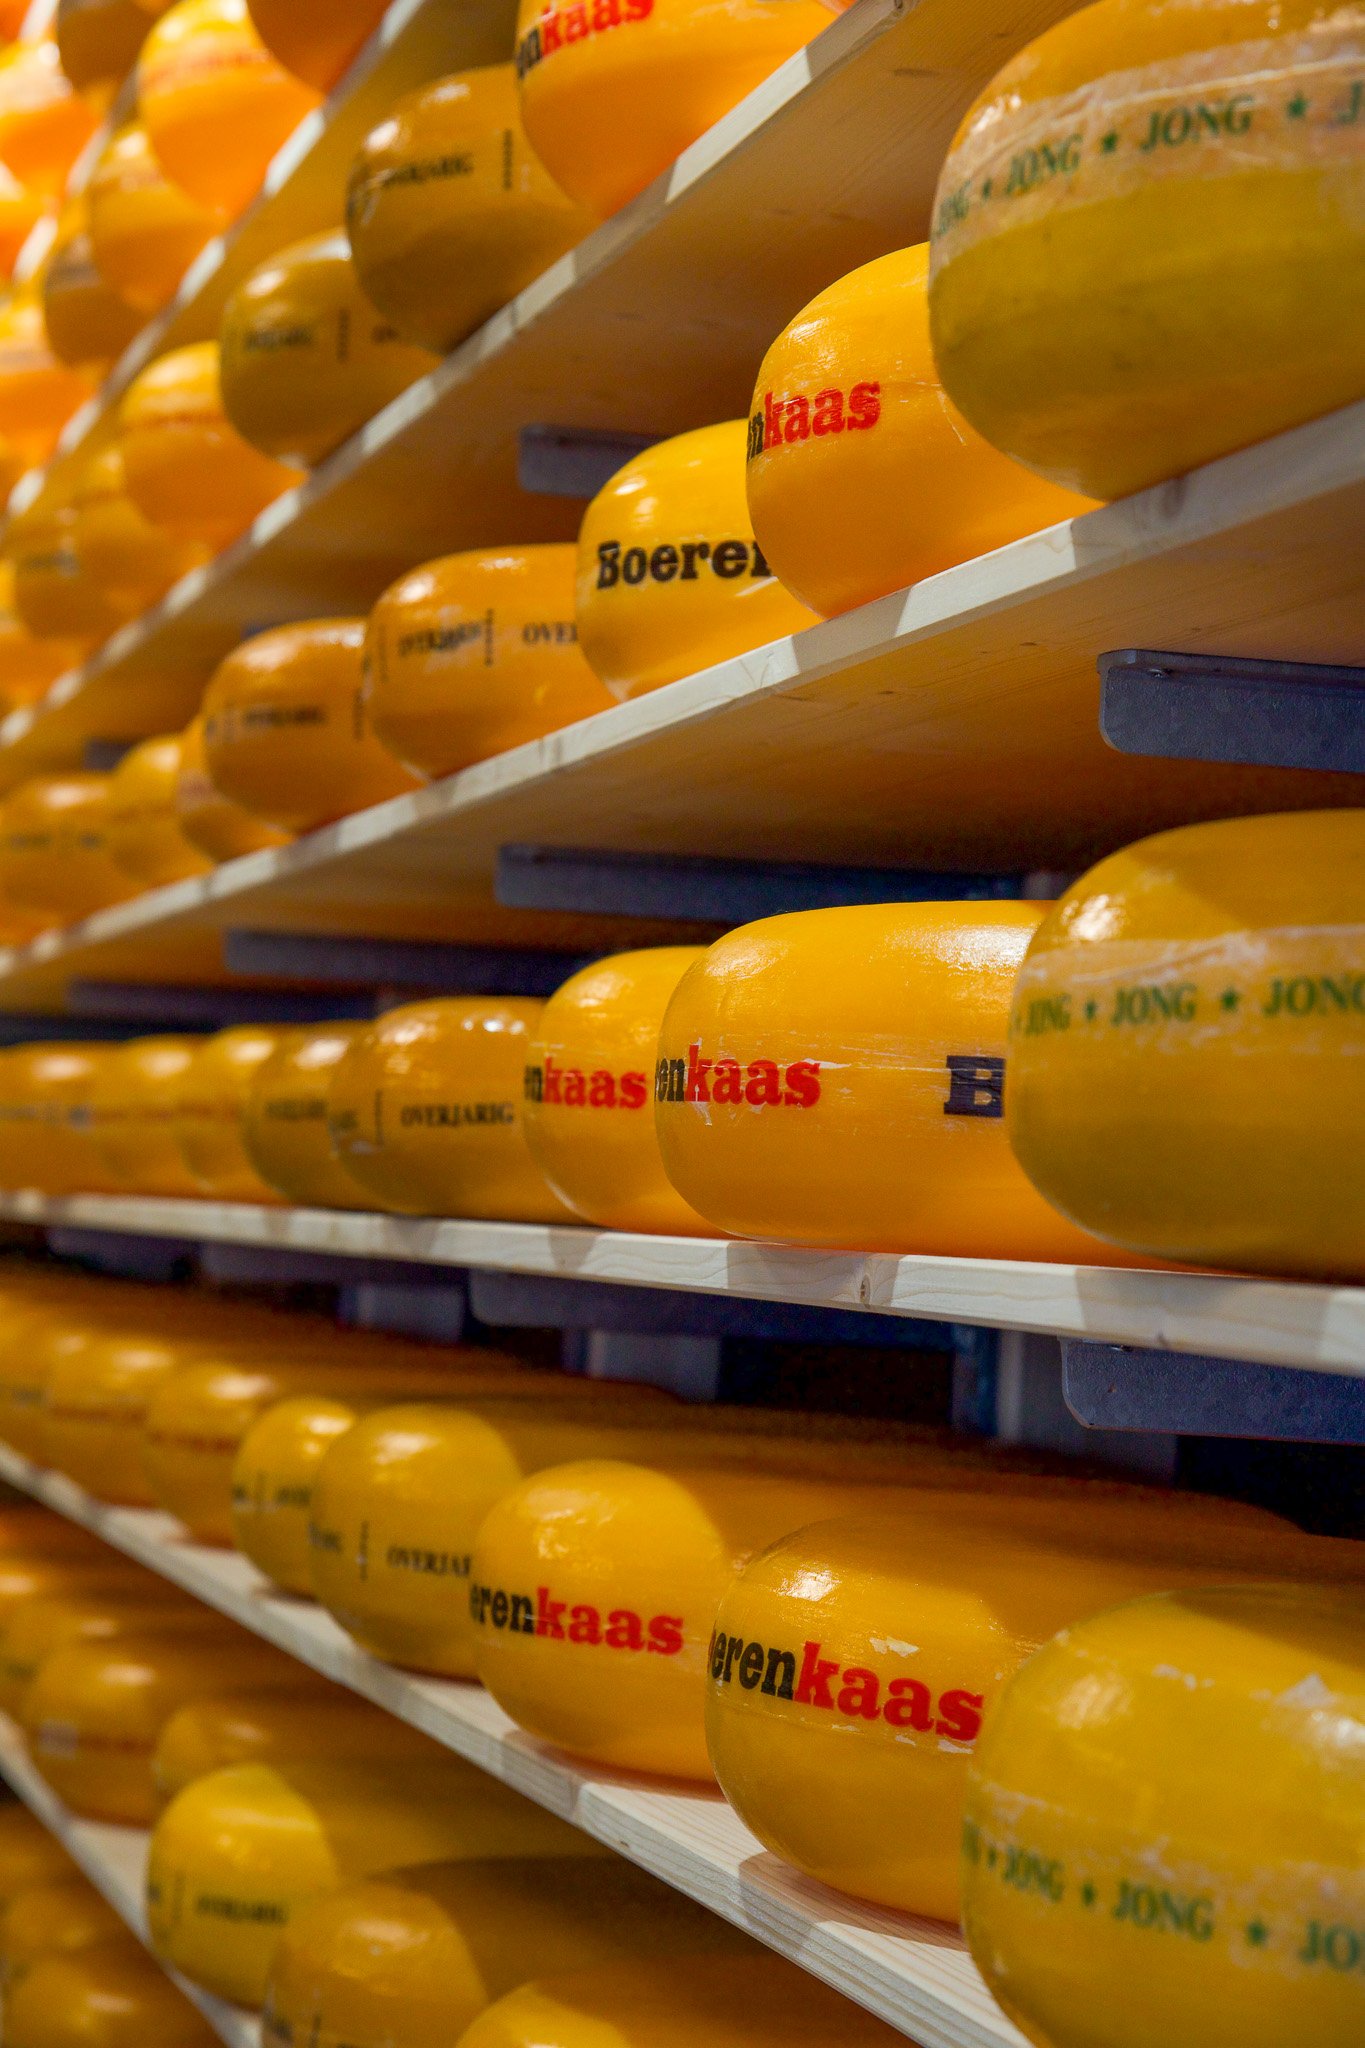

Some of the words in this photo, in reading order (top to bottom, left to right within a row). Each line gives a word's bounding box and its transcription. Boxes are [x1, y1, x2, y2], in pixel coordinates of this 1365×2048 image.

[1004, 132, 1083, 196] JONG
[1140, 95, 1255, 154] JONG
[1111, 983, 1197, 1027] JONG
[707, 1627, 985, 1741] erenkaas
[1113, 1876, 1216, 1943] JONG
[1299, 1919, 1365, 1974] JO
